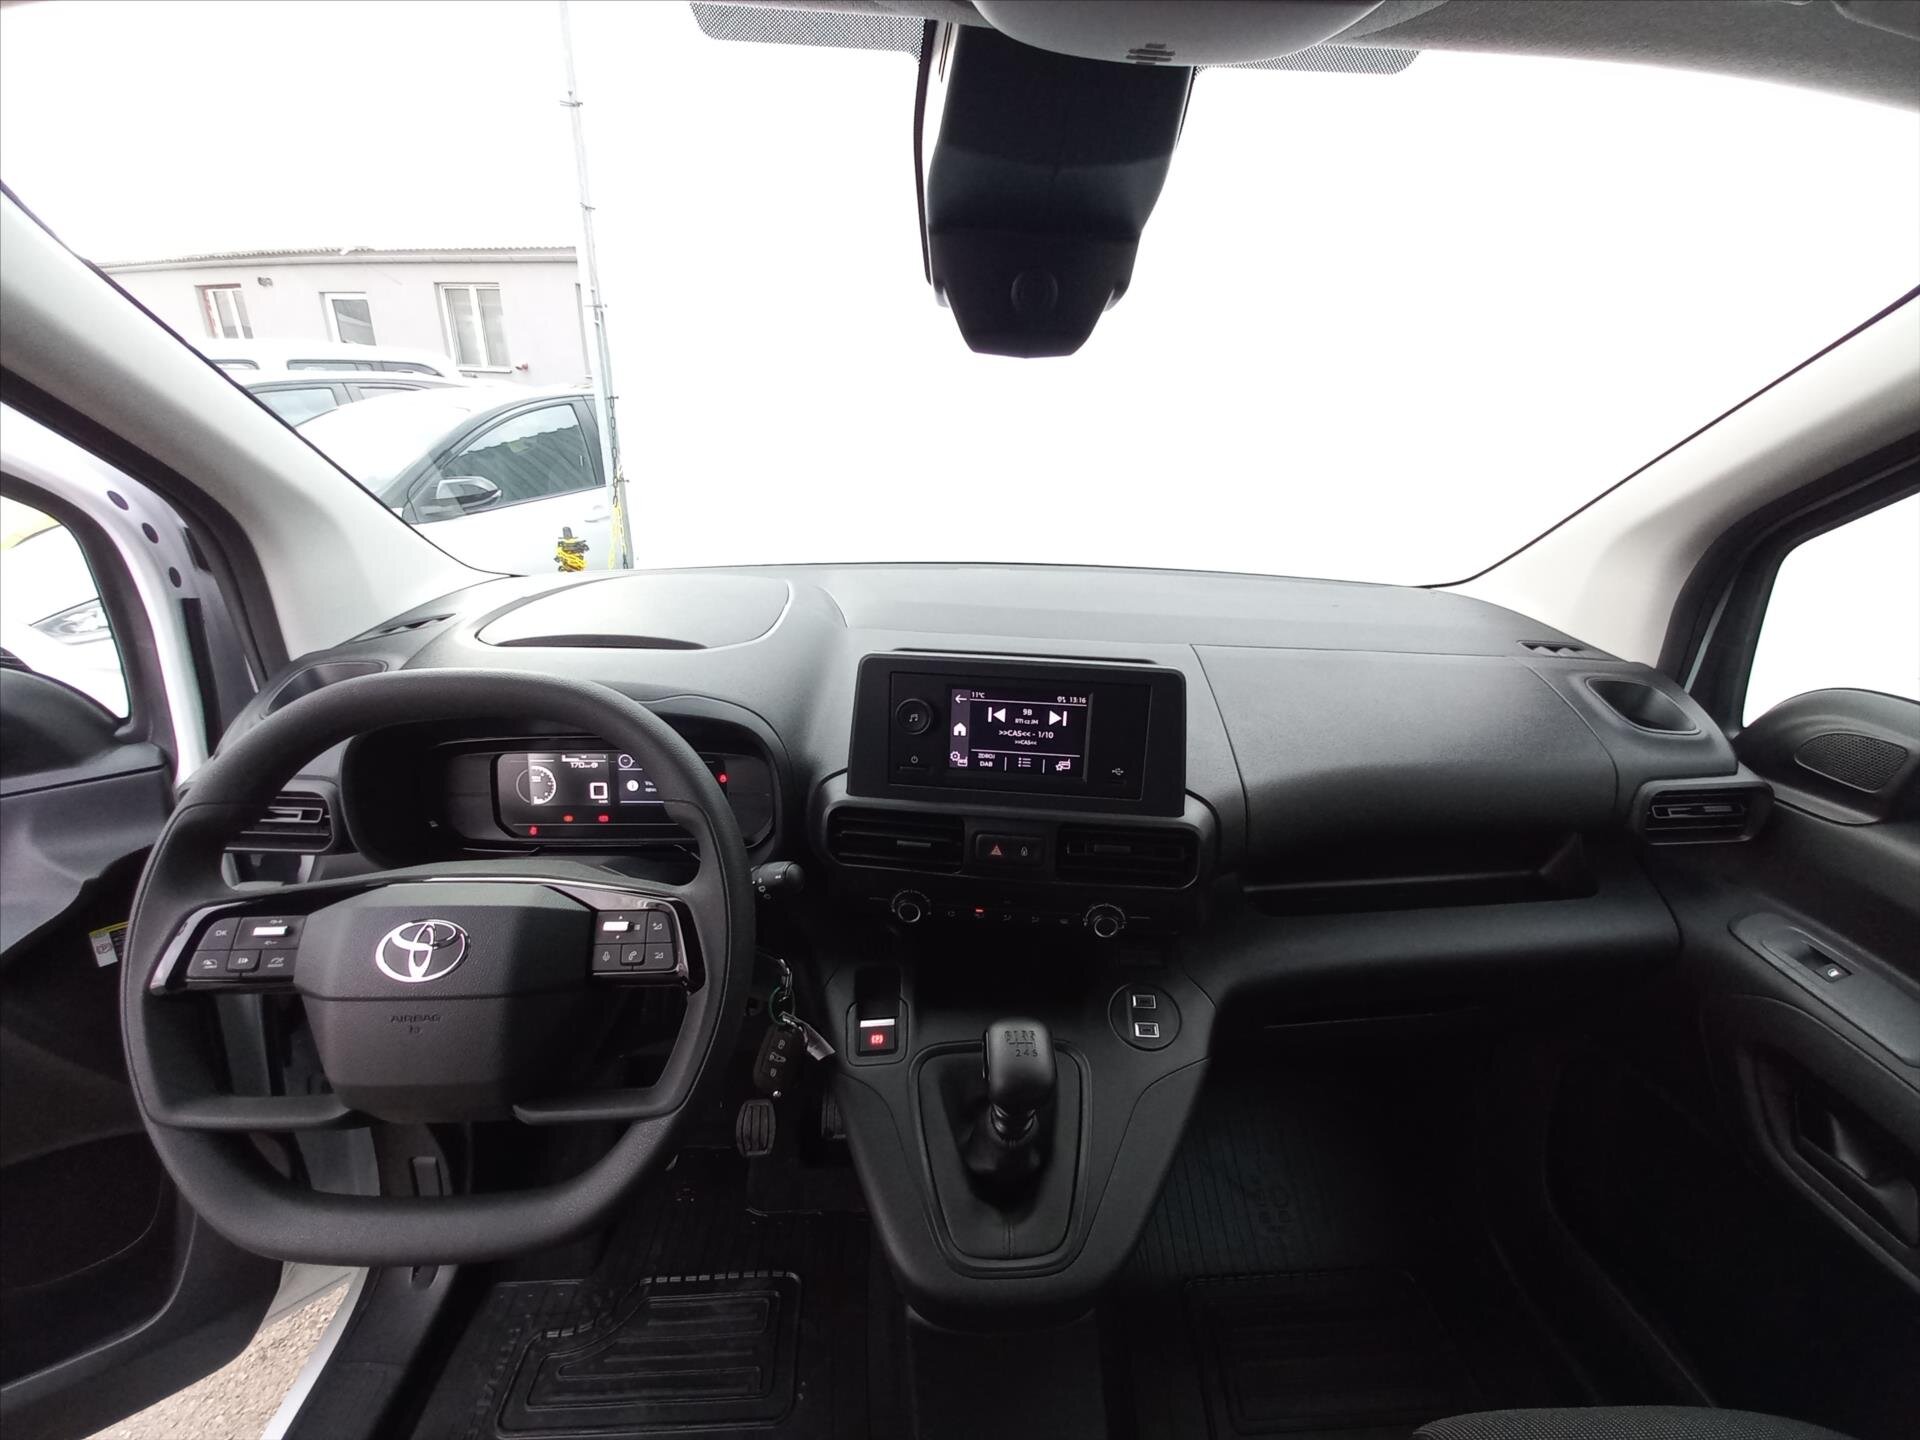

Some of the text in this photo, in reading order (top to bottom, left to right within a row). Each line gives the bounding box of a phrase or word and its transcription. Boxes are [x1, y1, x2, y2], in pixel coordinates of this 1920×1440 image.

[1069, 696, 1087, 704] 13:16
[1038, 731, 1054, 739] 1/10
[979, 760, 993, 768] DAB
[390, 1015, 441, 1023] AIRBAG
